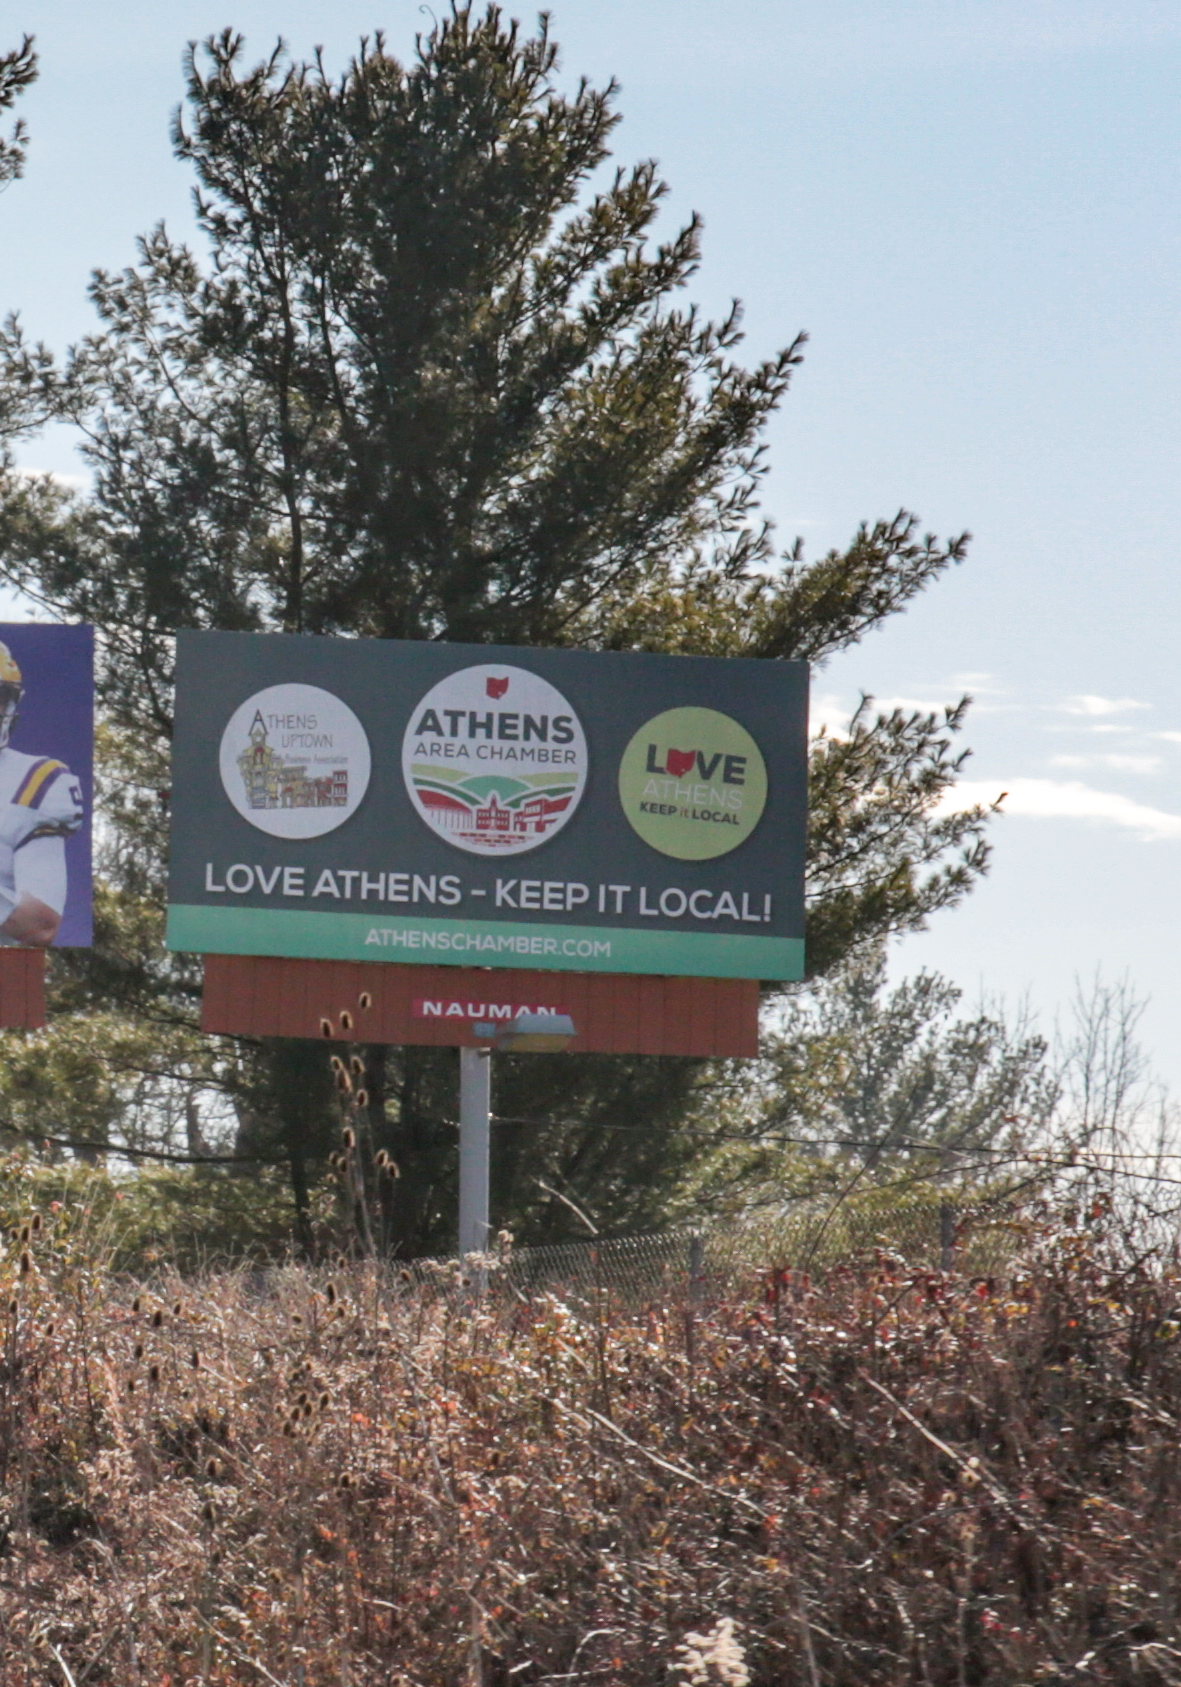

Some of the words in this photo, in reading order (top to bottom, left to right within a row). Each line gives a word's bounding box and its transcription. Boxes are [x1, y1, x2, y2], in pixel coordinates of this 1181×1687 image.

[248, 708, 318, 737] ATHENS
[414, 708, 575, 745] ATHENS
[281, 733, 334, 748] UPTOWN
[413, 742, 470, 759] AREA
[476, 745, 577, 765] CHAMBER
[642, 778, 744, 811] ATHENS
[639, 801, 678, 816] KEEP
[691, 809, 740, 826] LOCAL
[205, 863, 305, 897] LOVE
[312, 868, 461, 906] ATHENS
[494, 878, 590, 912] KEEP
[598, 883, 631, 914] IT
[639, 887, 772, 923] LOCAL!
[364, 929, 612, 959] ATHENSCHAMBER.COM
[422, 1001, 556, 1019] NAUMAN
